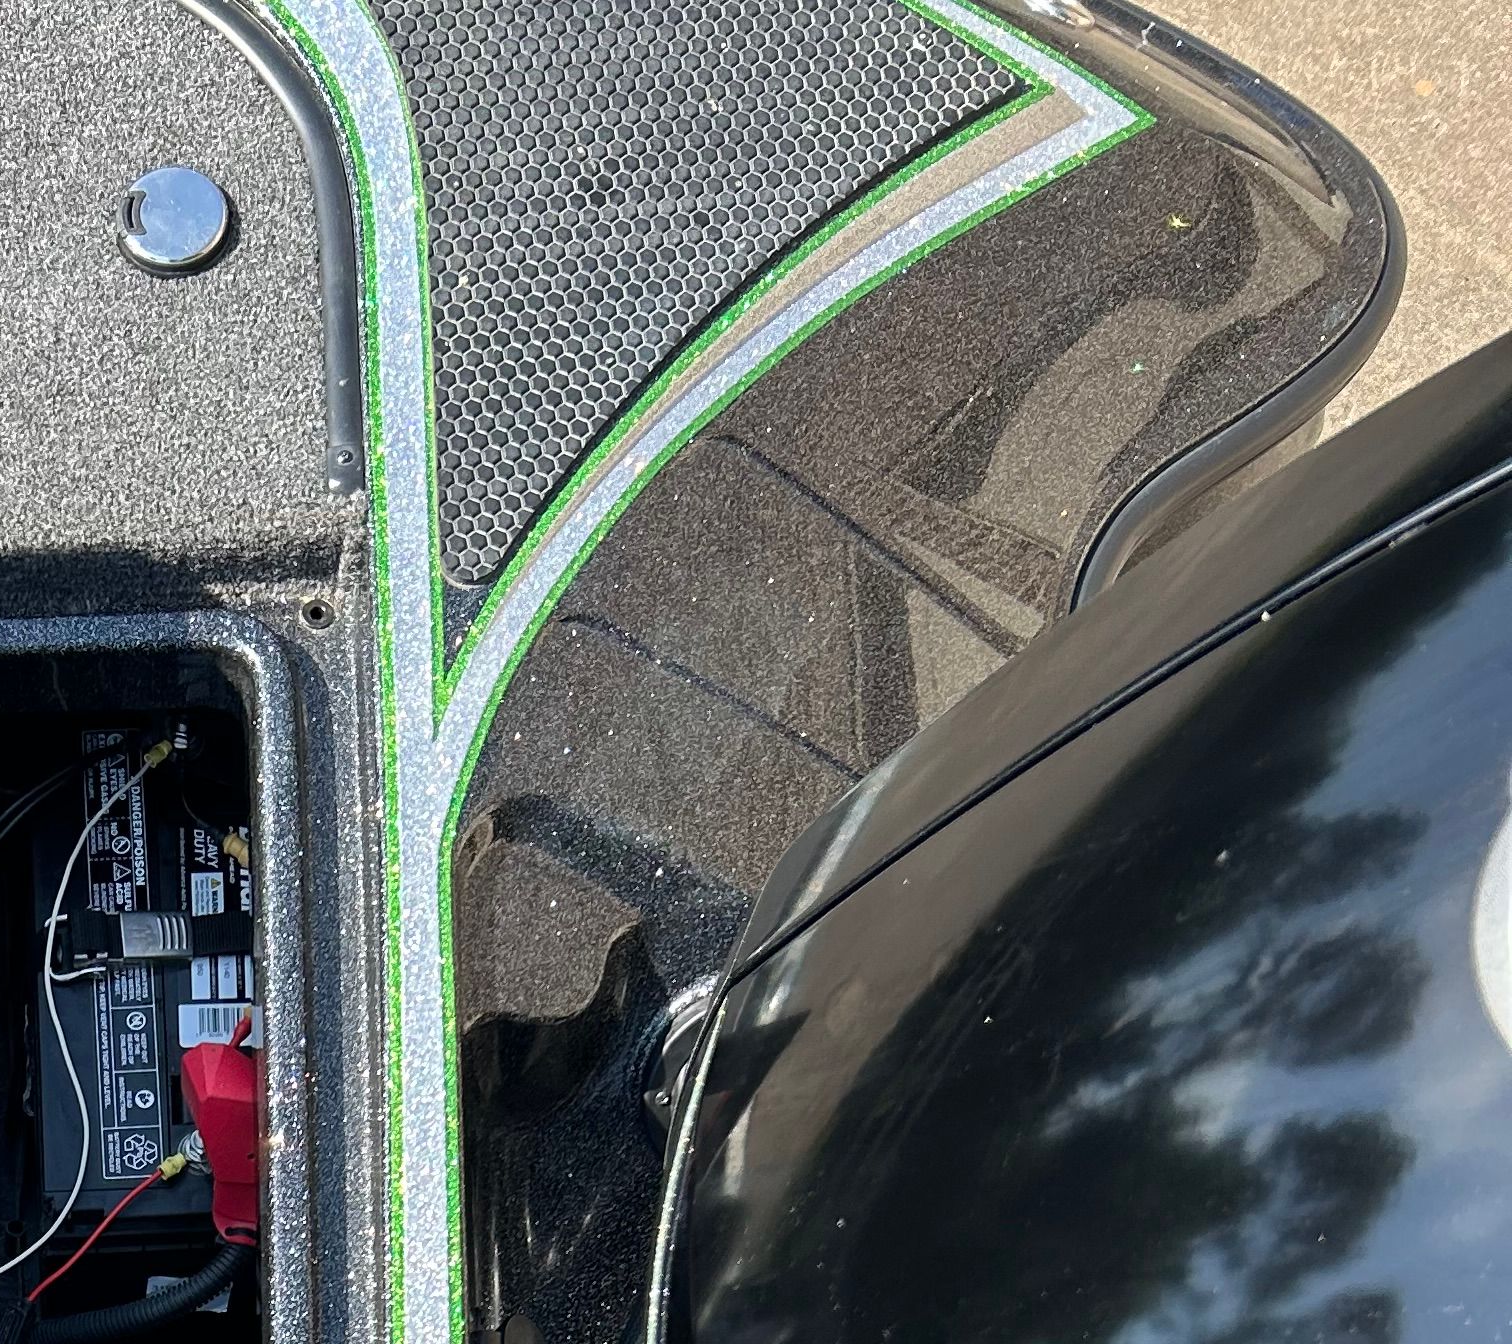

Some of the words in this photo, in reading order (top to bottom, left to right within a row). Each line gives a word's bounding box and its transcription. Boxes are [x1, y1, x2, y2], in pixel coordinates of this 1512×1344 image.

[131, 785, 146, 886] DANGER/POISON
[193, 829, 206, 865] DUTY
[115, 882, 124, 905] ACID
[123, 881, 132, 911] SULFU
[211, 890, 219, 913] WARN
[100, 1012, 108, 1030] VENT
[101, 1031, 109, 1049] CAPS
[102, 1050, 110, 1070] TIGHT
[103, 1070, 111, 1086] AND
